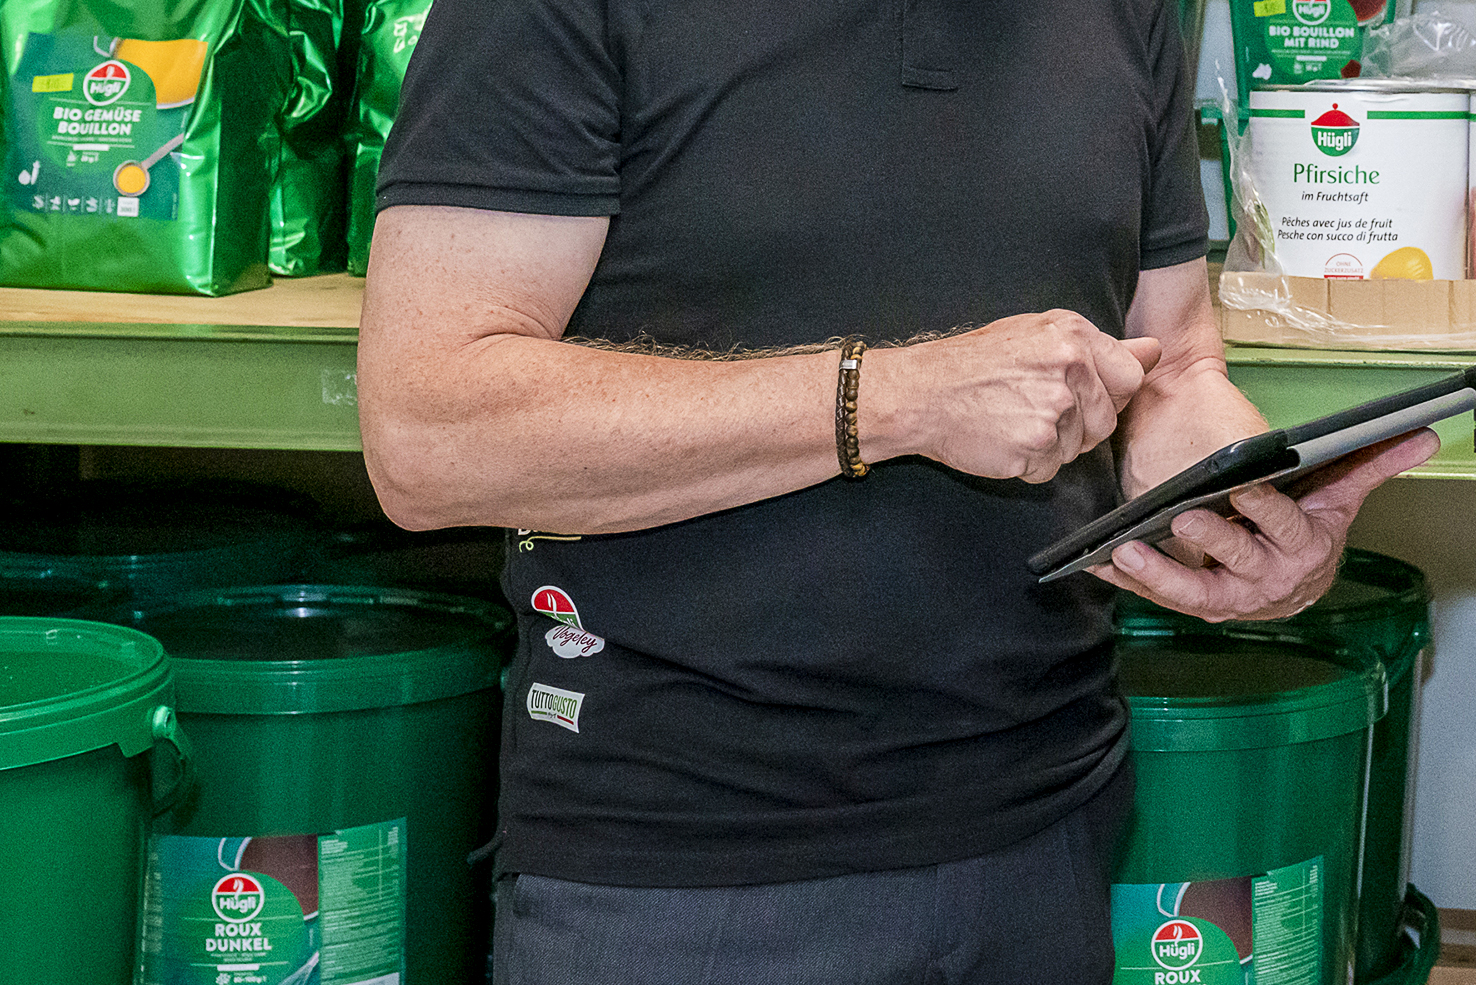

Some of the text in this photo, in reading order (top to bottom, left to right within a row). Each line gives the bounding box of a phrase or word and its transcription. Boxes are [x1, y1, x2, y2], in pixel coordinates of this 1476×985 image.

[1269, 25, 1354, 37] BIO BOUILLON
[1284, 38, 1339, 48] MIT RIND
[53, 107, 142, 122] BIO GEMÜSE
[58, 121, 132, 135] BOUILLON
[1317, 131, 1352, 151] Hügli
[1294, 163, 1380, 184] Pfirsiche
[1301, 191, 1369, 204] im Fruchtsaft
[1282, 216, 1392, 231] Pêches avec jus de fruit
[1278, 230, 1398, 244] Pesche con succo di frutta
[531, 689, 577, 719] TUTTOGUSTO
[219, 897, 256, 913] Hügli
[215, 923, 262, 937] ROUX
[206, 937, 272, 952] DUNKEL
[1159, 943, 1196, 960] Hügli
[1155, 970, 1201, 985] ROUX
